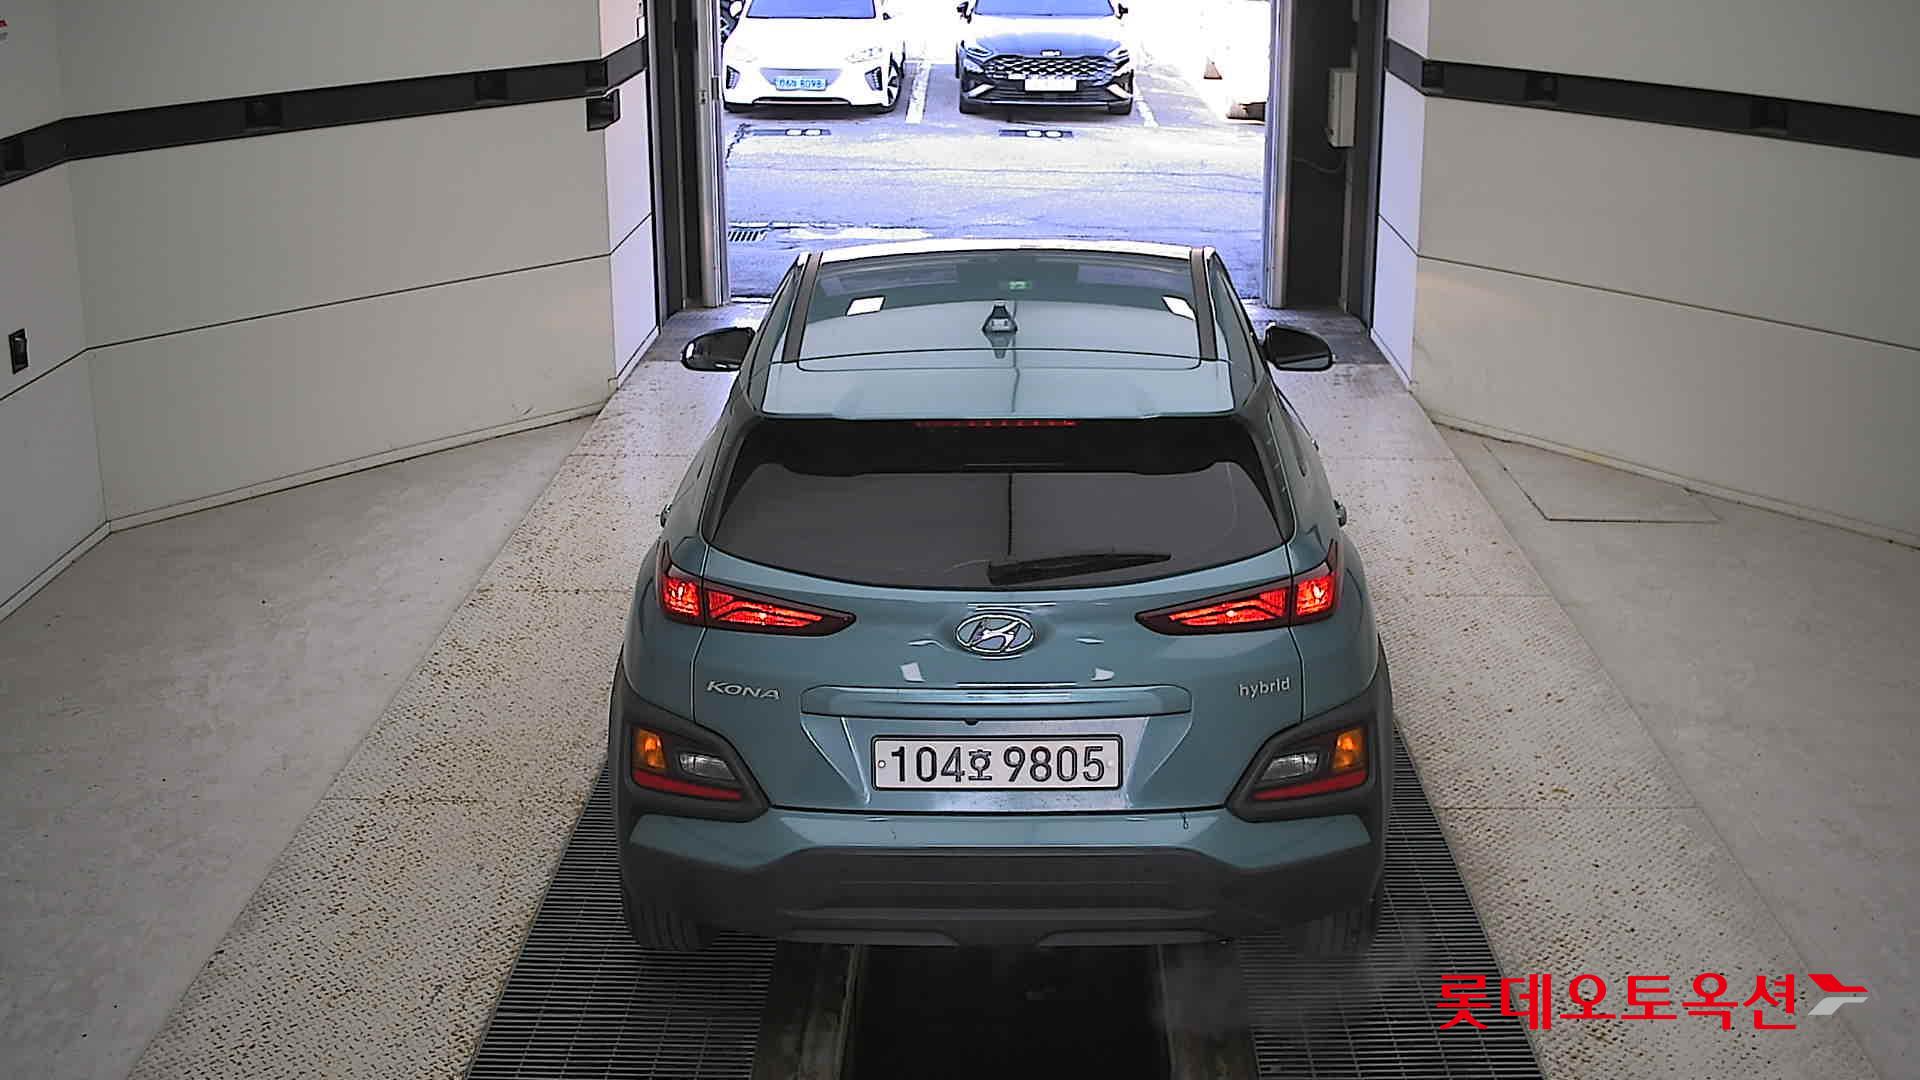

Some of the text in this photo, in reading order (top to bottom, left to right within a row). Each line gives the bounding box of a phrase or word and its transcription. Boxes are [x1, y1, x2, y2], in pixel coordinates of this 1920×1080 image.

[706, 681, 780, 700] KONA
[1239, 676, 1290, 699] hybrid
[891, 745, 1105, 783] 104호 9805
